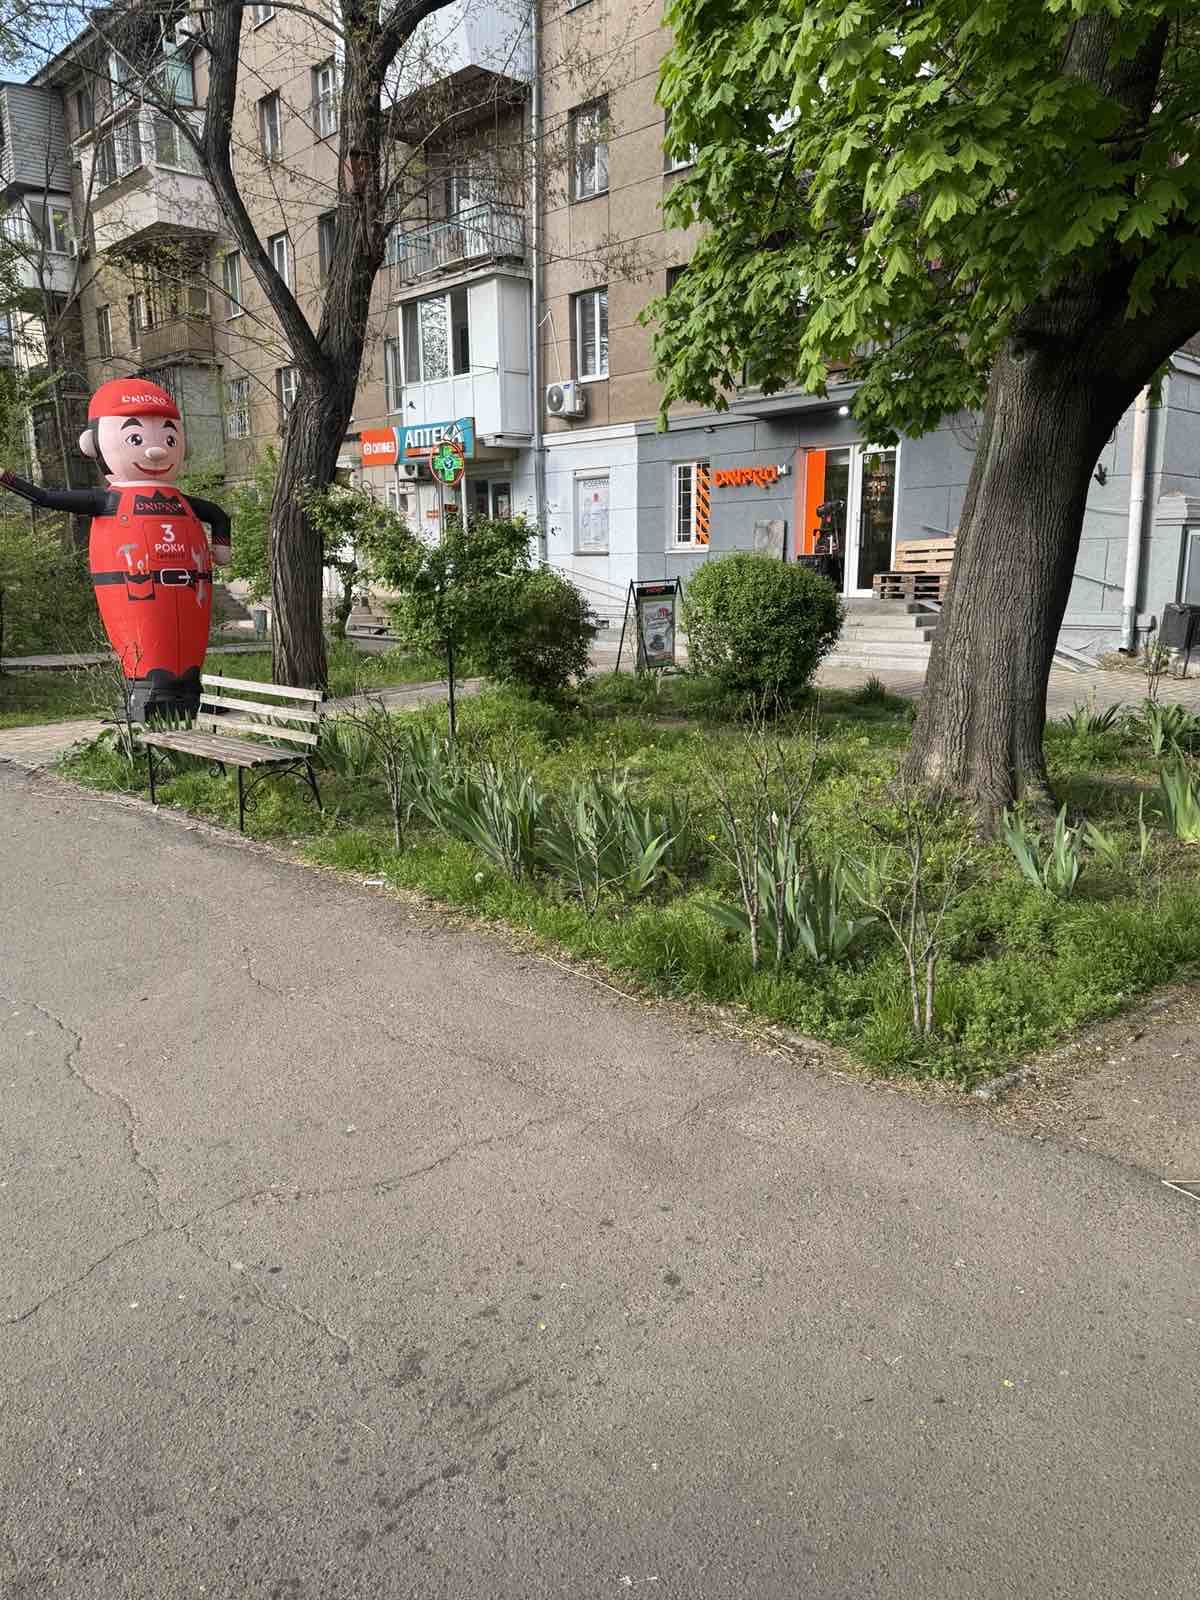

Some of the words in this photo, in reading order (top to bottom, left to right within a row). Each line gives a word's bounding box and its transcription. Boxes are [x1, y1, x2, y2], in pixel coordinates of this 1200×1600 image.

[405, 423, 462, 448] АПТЕКА
[160, 524, 175, 542] 3
[155, 543, 185, 552] РОКИ
